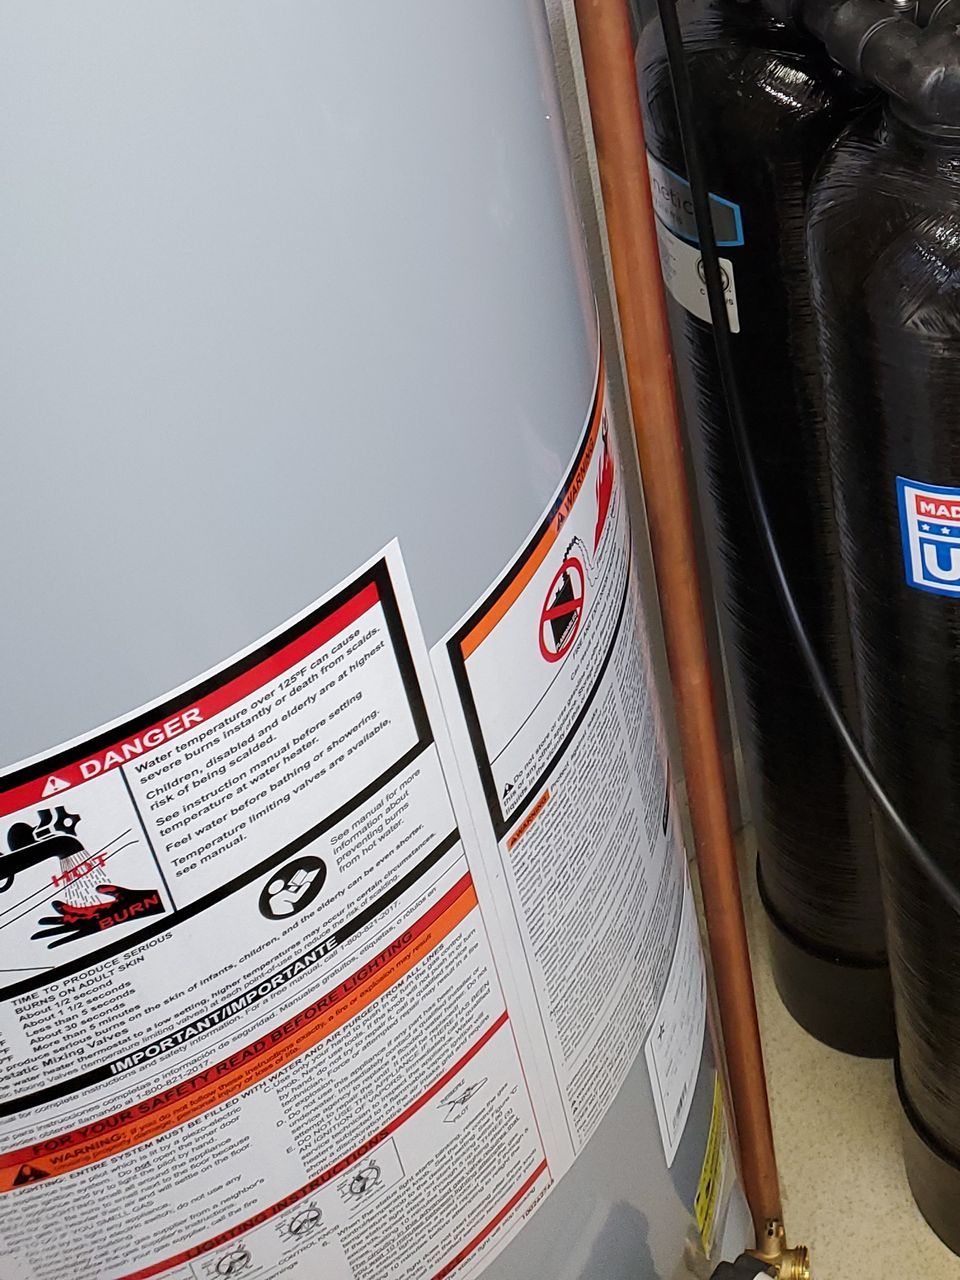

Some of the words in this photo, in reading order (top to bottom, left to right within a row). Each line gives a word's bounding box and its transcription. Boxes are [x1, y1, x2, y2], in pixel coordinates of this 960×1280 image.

[134, 750, 172, 773] Water
[174, 708, 248, 753] temperature
[250, 689, 275, 709] over
[309, 652, 329, 669] can
[330, 629, 360, 654] cause
[139, 758, 182, 784] severe
[183, 736, 220, 760] burns
[222, 704, 272, 739] instantly
[274, 694, 287, 706] or
[288, 673, 319, 697] death
[319, 653, 344, 675] from
[345, 627, 380, 655] scalds.
[145, 768, 203, 799] Children,
[205, 733, 255, 768] disabled
[257, 718, 279, 737] and
[280, 692, 316, 721] elderly
[319, 680, 335, 695] are
[337, 669, 348, 682] at
[348, 640, 385, 672] highest
[79, 707, 203, 780] DANGER
[149, 794, 175, 811] risk
[176, 783, 189, 796] of
[191, 764, 226, 788] being
[228, 733, 277, 767] scalded.
[155, 810, 180, 826] See
[182, 771, 247, 813] instruction
[249, 742, 290, 774] manual
[292, 718, 326, 746] before
[328, 690, 362, 720] setting
[159, 792, 233, 837] temperature
[235, 782, 248, 794] at
[248, 761, 280, 785] water
[282, 736, 319, 764] heater.
[165, 832, 192, 852] Feel
[194, 813, 228, 836] water
[229, 790, 267, 816] before
[269, 760, 311, 791] bathing
[312, 749, 324, 762] or
[326, 709, 380, 752] showering.
[170, 822, 246, 867] Temperature
[248, 793, 290, 823] limiting
[292, 767, 326, 794] valves
[328, 754, 345, 769] are
[346, 719, 391, 756] available,
[330, 828, 349, 845] See
[351, 798, 384, 830] manual
[385, 787, 397, 802] for
[398, 768, 420, 790] more
[175, 862, 197, 877] see
[199, 833, 247, 864] manual.
[332, 812, 383, 855] information
[384, 789, 409, 814] about
[335, 823, 383, 866] preventing
[338, 854, 360, 873] from
[361, 839, 377, 856] hot
[377, 818, 404, 842] water.
[51, 852, 107, 887] HOT
[99, 894, 158, 929] BURN
[10, 991, 39, 1006] TIME
[42, 984, 59, 994] TO
[62, 957, 120, 987] PRODUCE
[122, 931, 173, 960] SERIOUS
[14, 994, 56, 1015] BURNS
[58, 986, 76, 997] ON
[78, 968, 114, 990] ADULT
[117, 954, 144, 972] SKIN
[18, 1005, 52, 1022] About
[54, 997, 71, 1008] 1/2
[72, 979, 113, 1001] second
[22, 1013, 56, 1030] About
[66, 1001, 84, 1011] 1/2
[85, 980, 131, 1004] seconds
[25, 1024, 52, 1037] Less
[53, 1013, 79, 1026] than
[90, 988, 136, 1012] seconds
[29, 1028, 63, 1045] About
[64, 1022, 77, 1031] 30
[79, 1002, 126, 1025] seconds
[32, 1039, 60, 1053] More
[61, 1028, 87, 1041] than
[98, 1004, 141, 1027] minutes
[110, 936, 338, 1075] IMPORTANT/IMPORTANTE
[32, 1133, 72, 1159] FOR
[79, 1110, 133, 1143] YOUR
[138, 1072, 210, 1116] SAFETY
[214, 1039, 266, 1075] READ
[270, 994, 337, 1044] BEFORE
[342, 929, 415, 992] LIGHTING
[41, 1046, 85, 1067] Mixing
[85, 1027, 129, 1048] Valves
[49, 1132, 126, 1166] WARNING:
[187, 1212, 267, 1260] LIGHTING
[272, 1129, 390, 1214] INSTRUCTIONS
